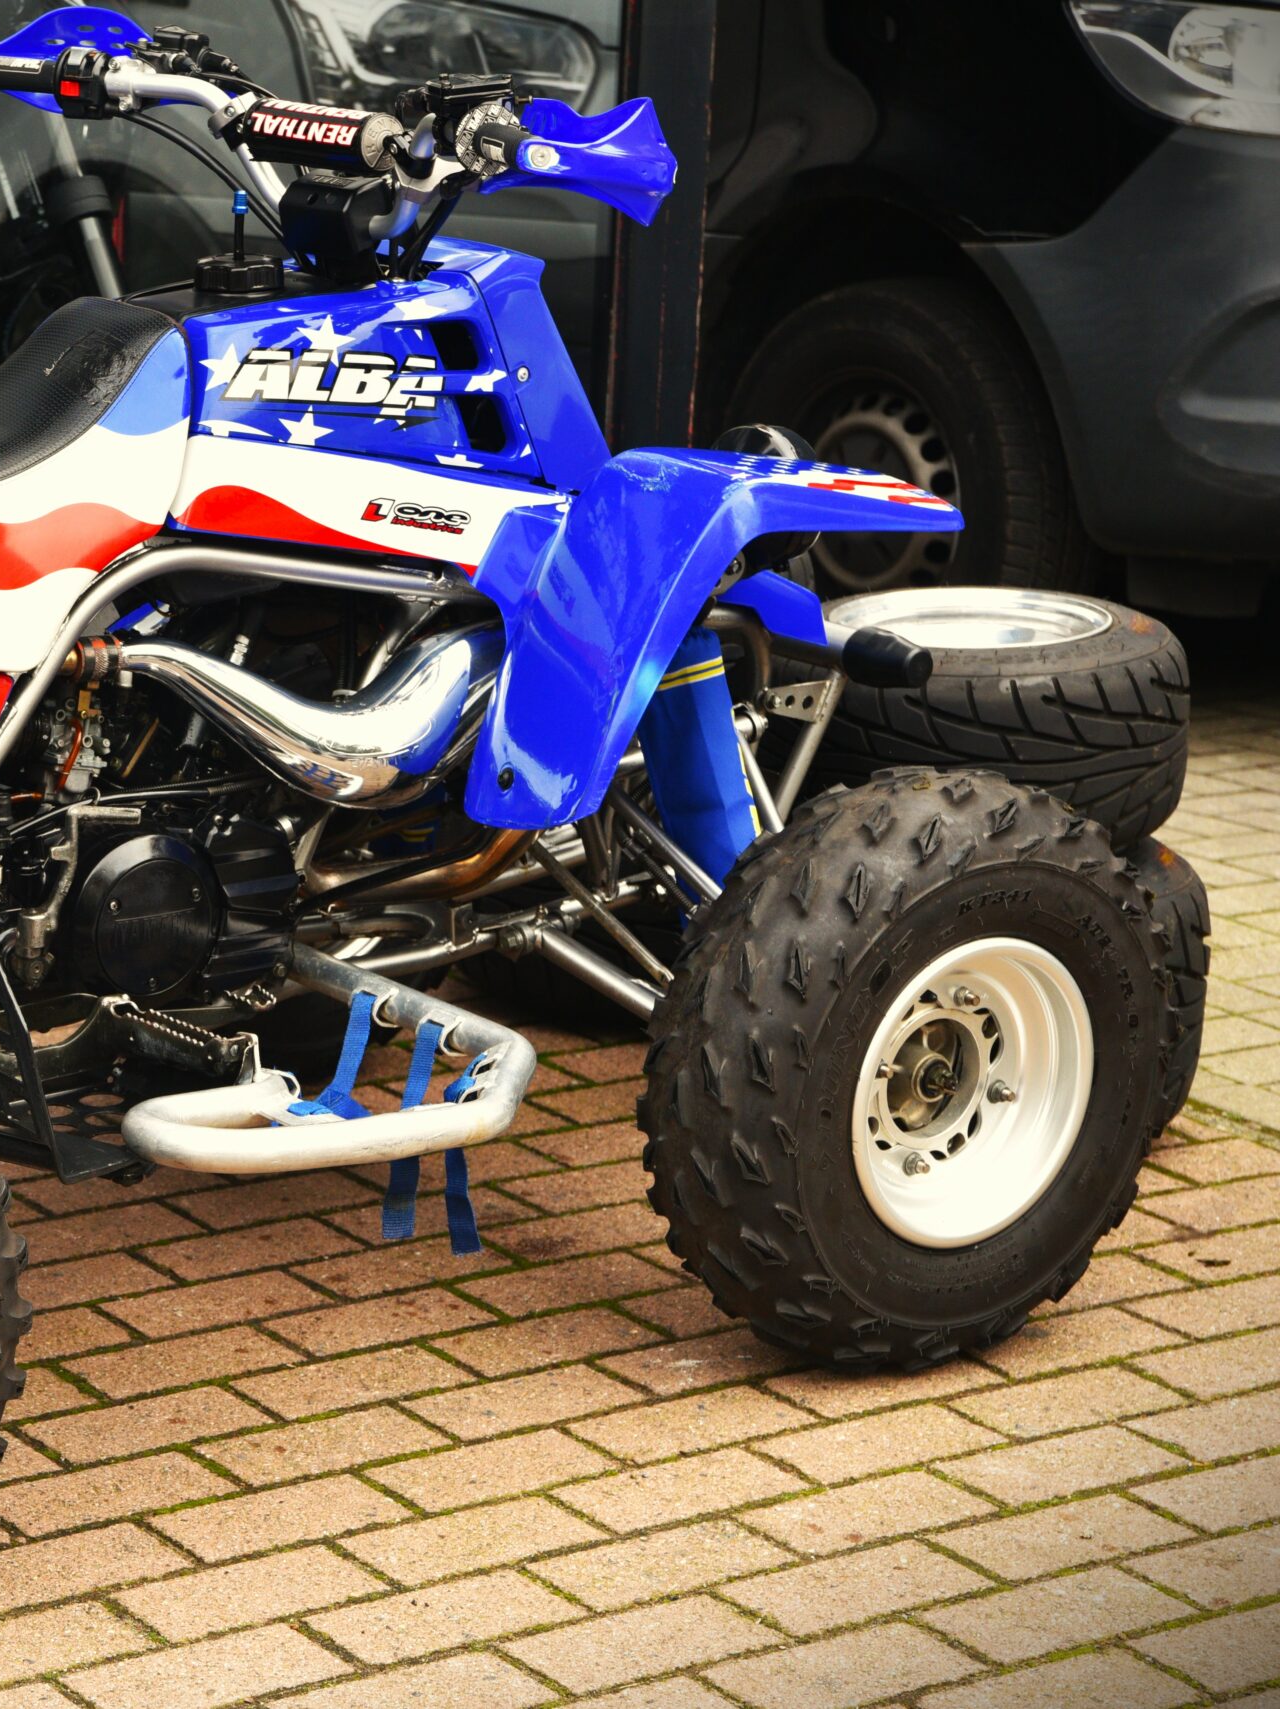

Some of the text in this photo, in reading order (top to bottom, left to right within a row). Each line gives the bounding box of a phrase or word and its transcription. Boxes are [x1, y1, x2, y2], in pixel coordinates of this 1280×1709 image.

[251, 112, 359, 146] RENTHAL
[222, 348, 445, 409] ALBA
[391, 516, 464, 535] industries
[393, 503, 471, 526] one
[957, 888, 1033, 917] KT341
